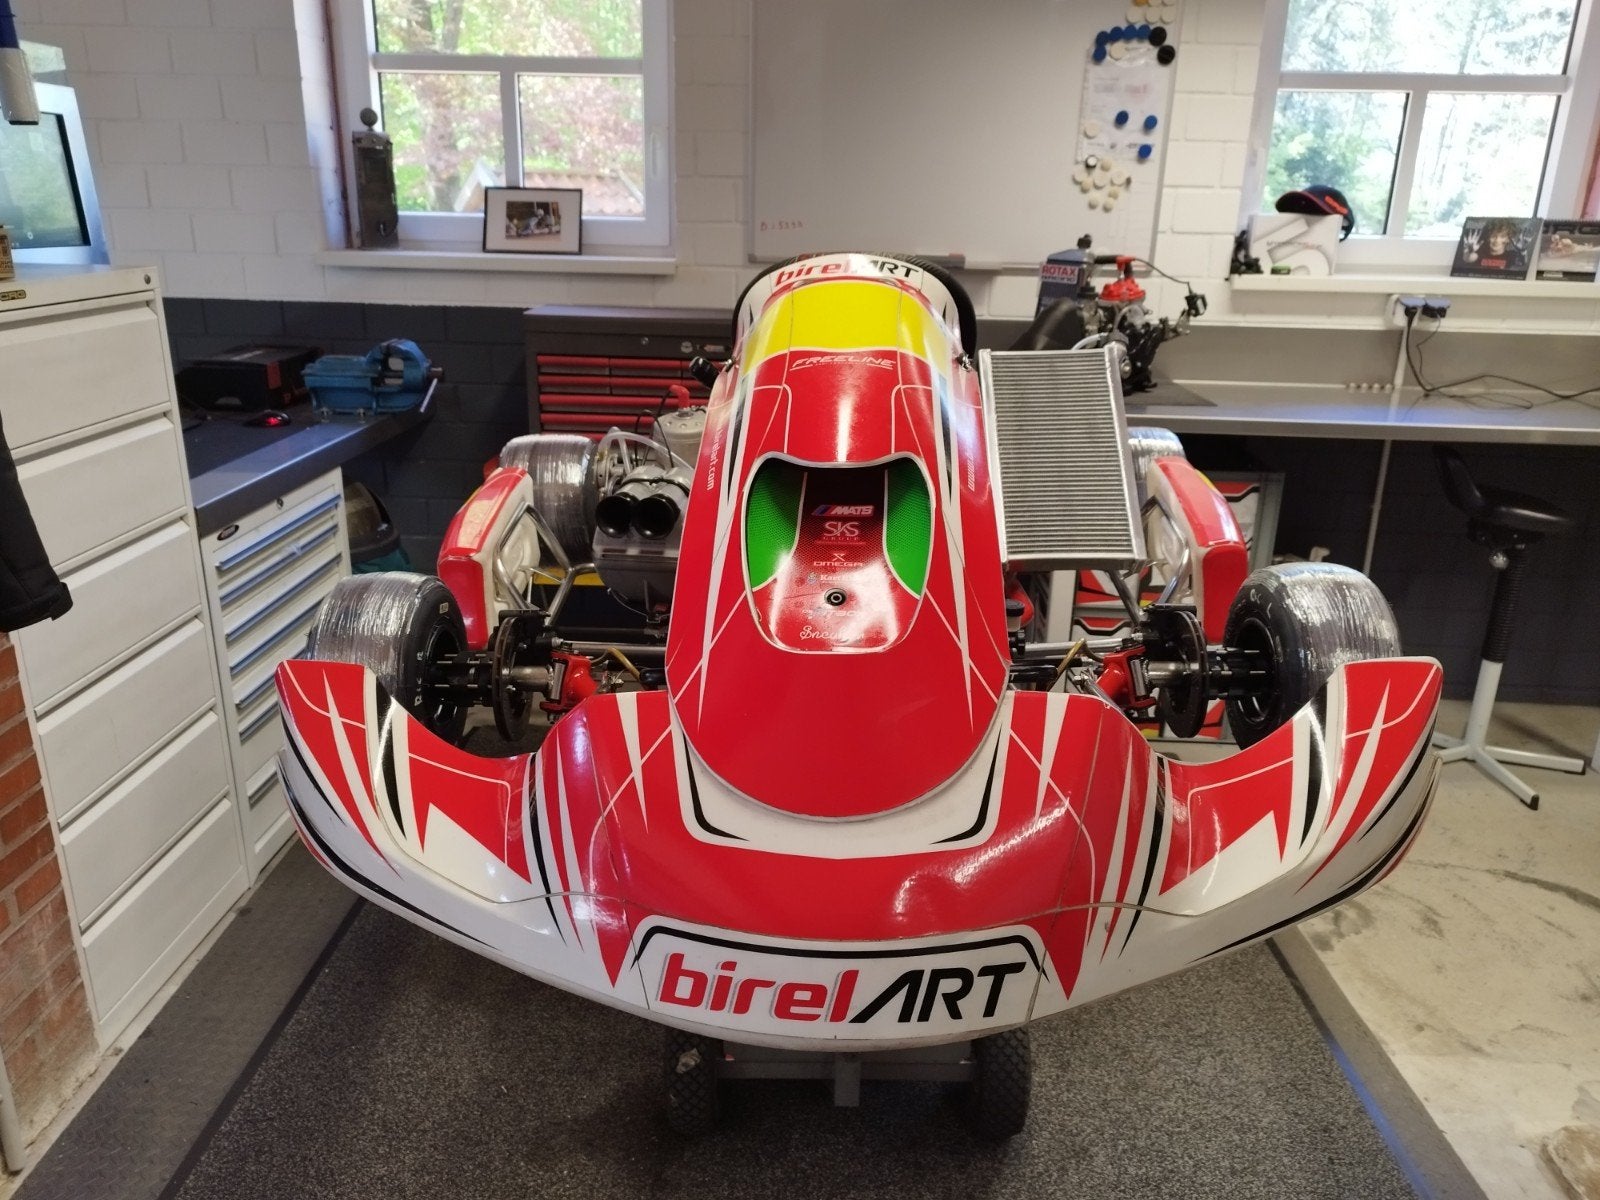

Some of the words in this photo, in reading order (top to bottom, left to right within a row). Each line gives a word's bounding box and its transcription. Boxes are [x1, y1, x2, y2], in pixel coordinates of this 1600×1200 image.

[1041, 265, 1077, 277] ROTAX
[791, 355, 897, 368] FREELINE
[823, 520, 860, 538] SKS
[658, 951, 1027, 1024] birelART
